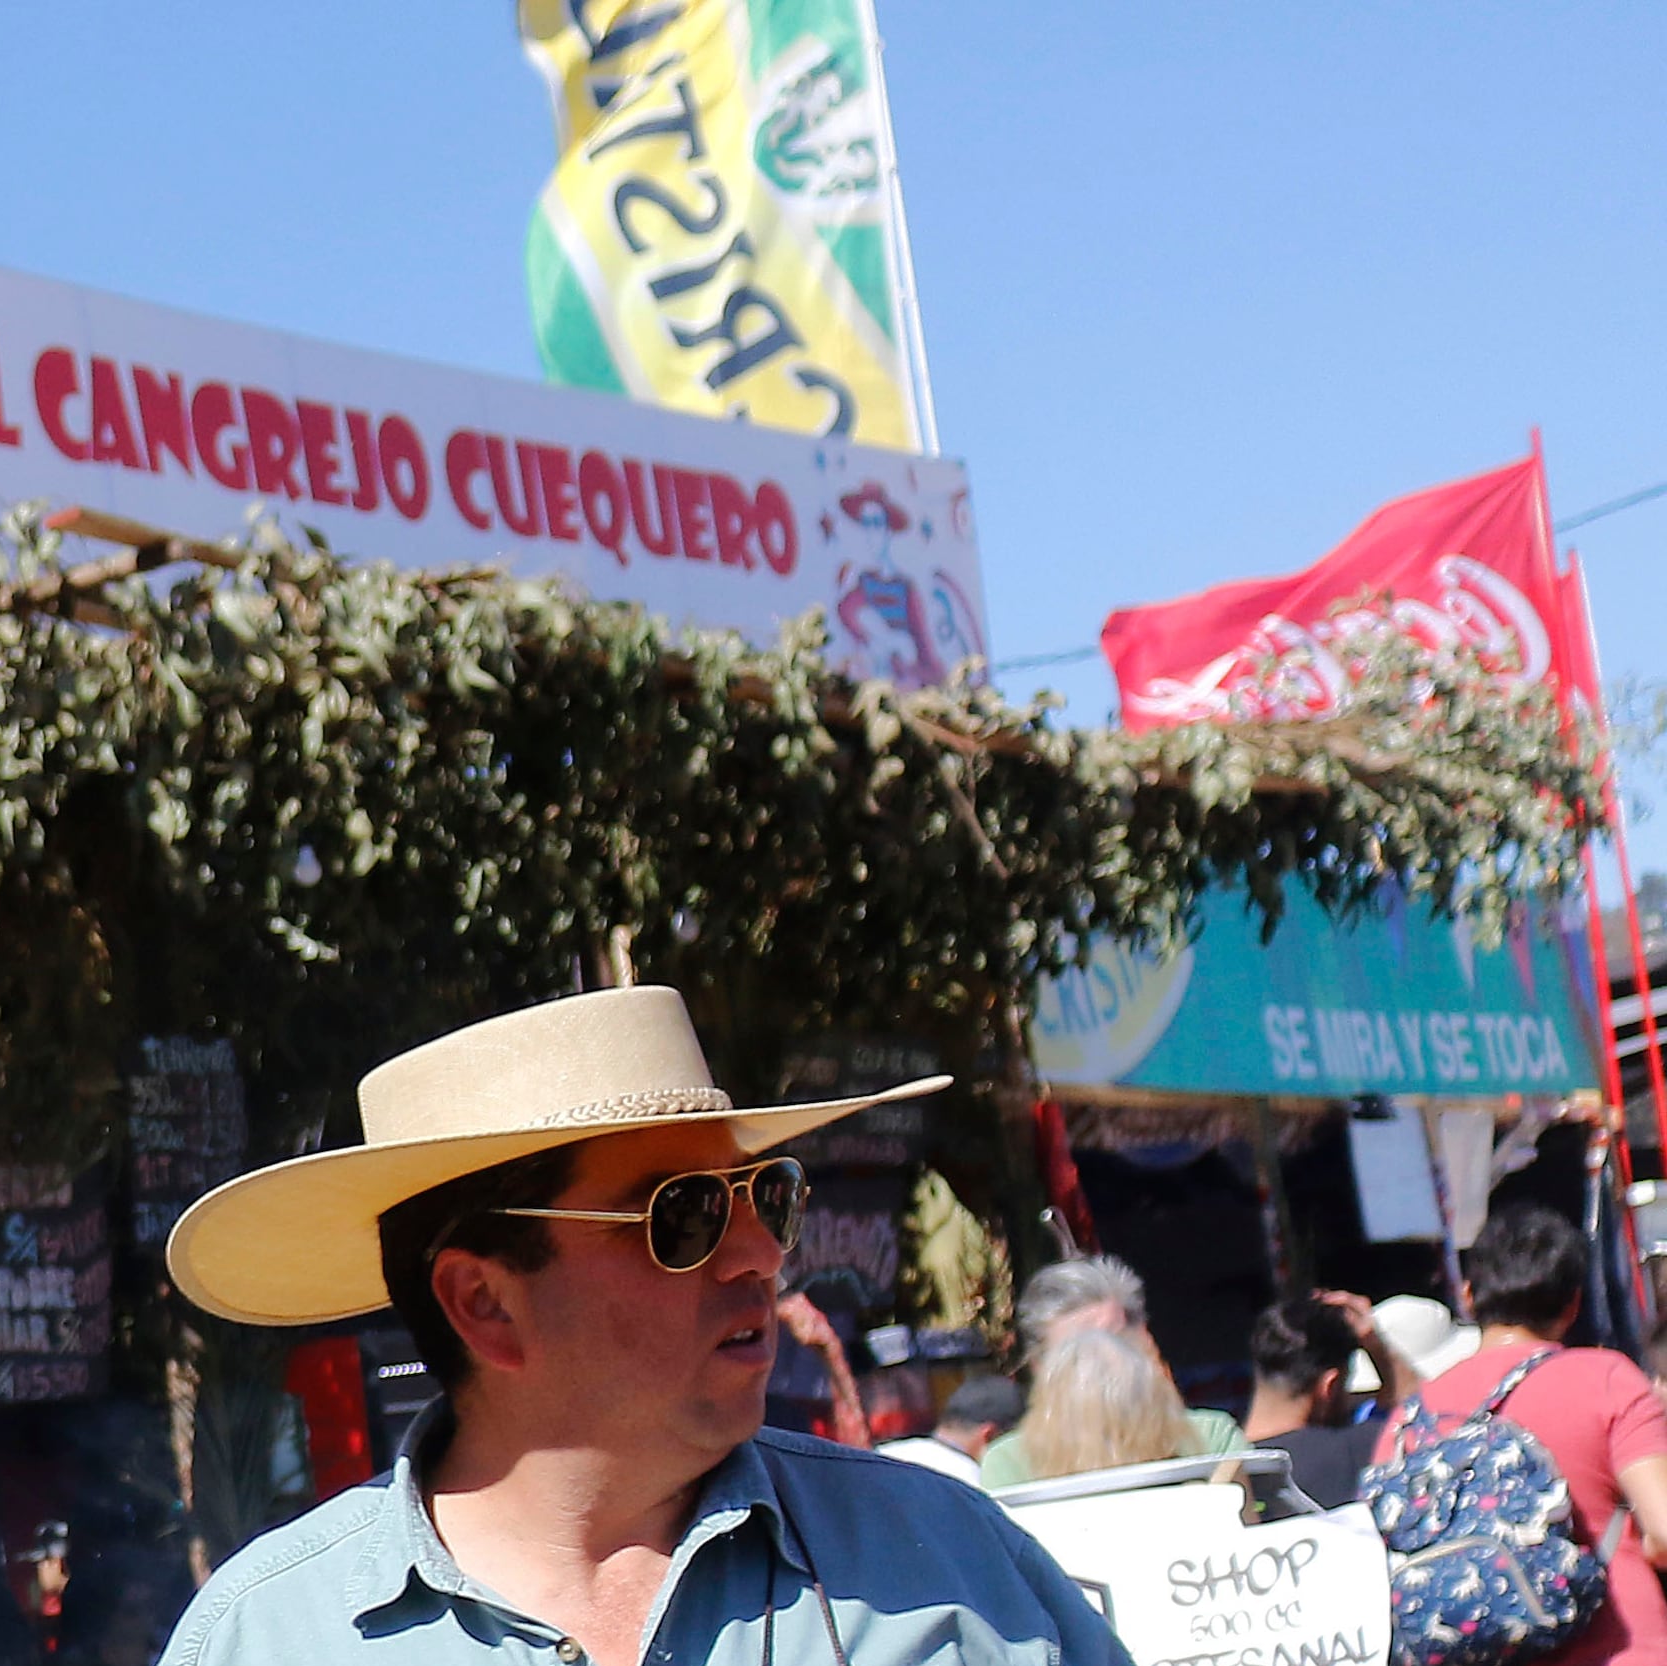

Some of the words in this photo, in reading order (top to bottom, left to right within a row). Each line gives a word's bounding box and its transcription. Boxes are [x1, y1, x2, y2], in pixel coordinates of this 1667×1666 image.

[34, 347, 429, 521] CANGREJO
[446, 429, 798, 576] CUEQUERO
[1265, 1003, 1316, 1080] SE
[1316, 1007, 1405, 1081] MIRA
[1398, 1010, 1426, 1080] Y
[1428, 1011, 1479, 1082] SE
[1475, 1013, 1568, 1082] TOCA
[1167, 1537, 1320, 1607] SHOP
[1189, 1609, 1253, 1643] 500
